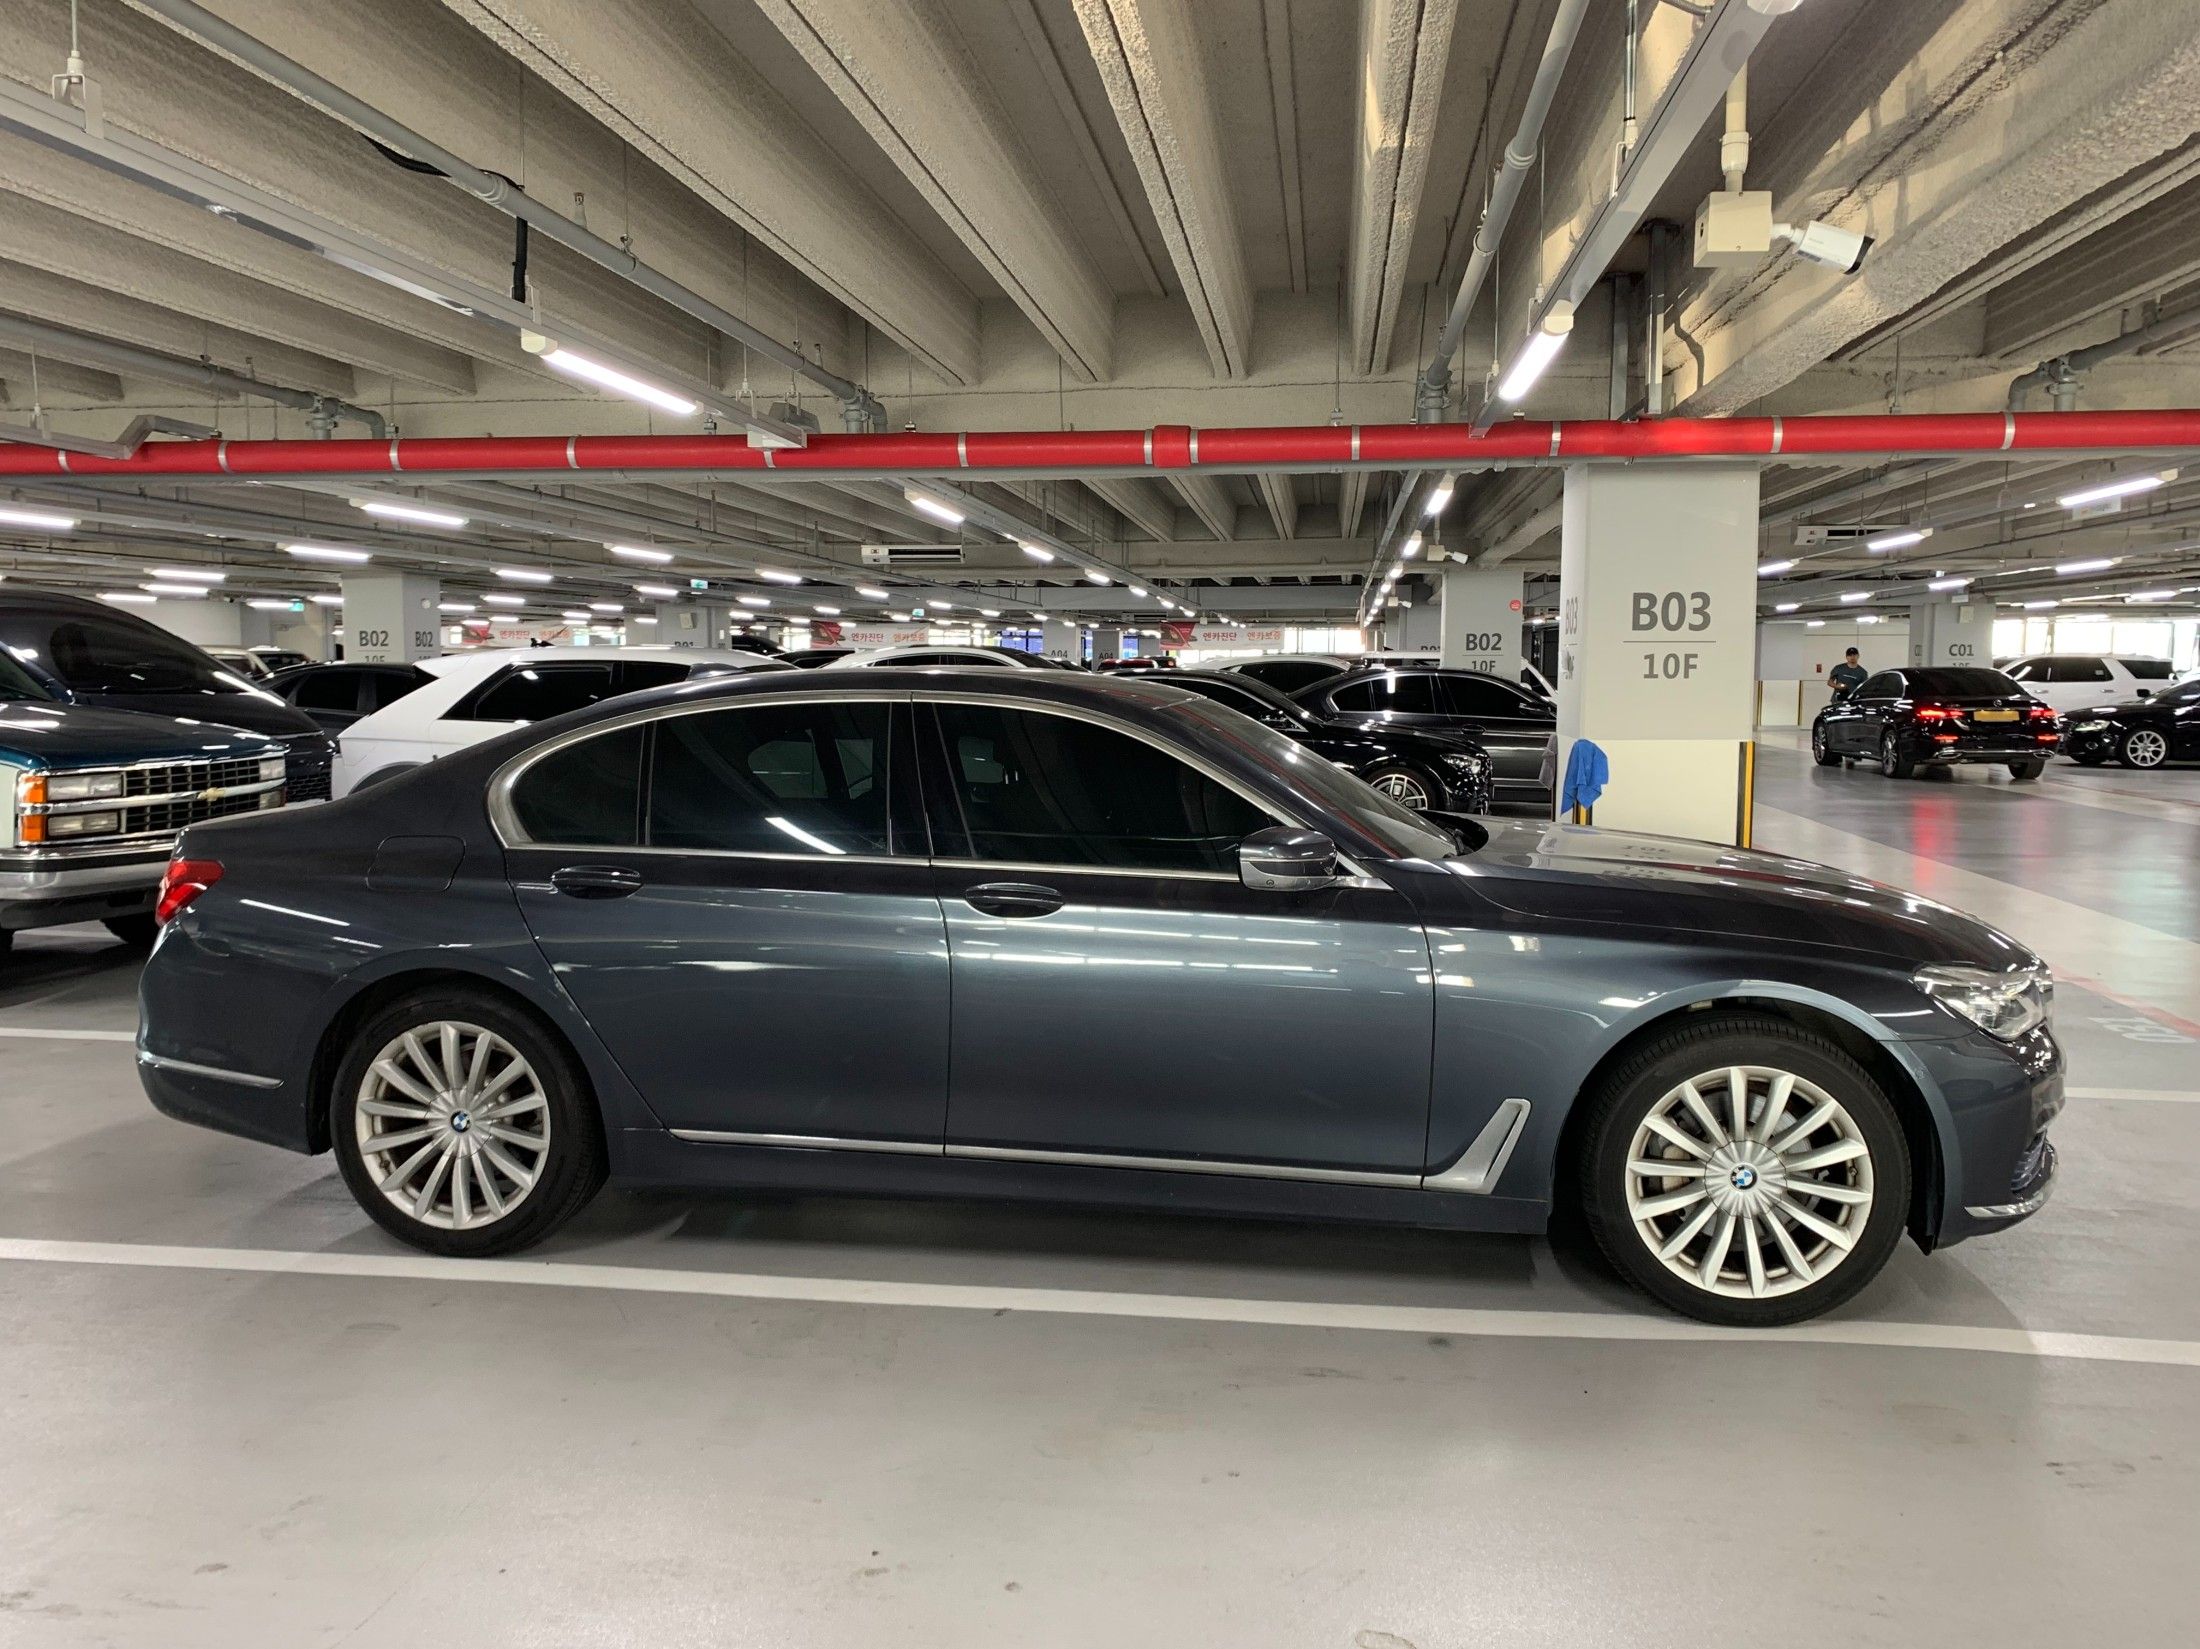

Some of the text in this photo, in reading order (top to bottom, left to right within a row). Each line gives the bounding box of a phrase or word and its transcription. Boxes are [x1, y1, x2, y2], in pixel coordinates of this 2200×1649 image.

[1632, 592, 1711, 631] B03
[359, 630, 389, 647] B02
[415, 631, 433, 647] B02
[1203, 631, 1237, 641] 엔카진단
[1466, 633, 1502, 650] B02
[1050, 650, 1068, 659] A04
[1949, 644, 1974, 656] C01
[1471, 660, 1496, 672] 10F
[1644, 653, 1698, 679] 10F
